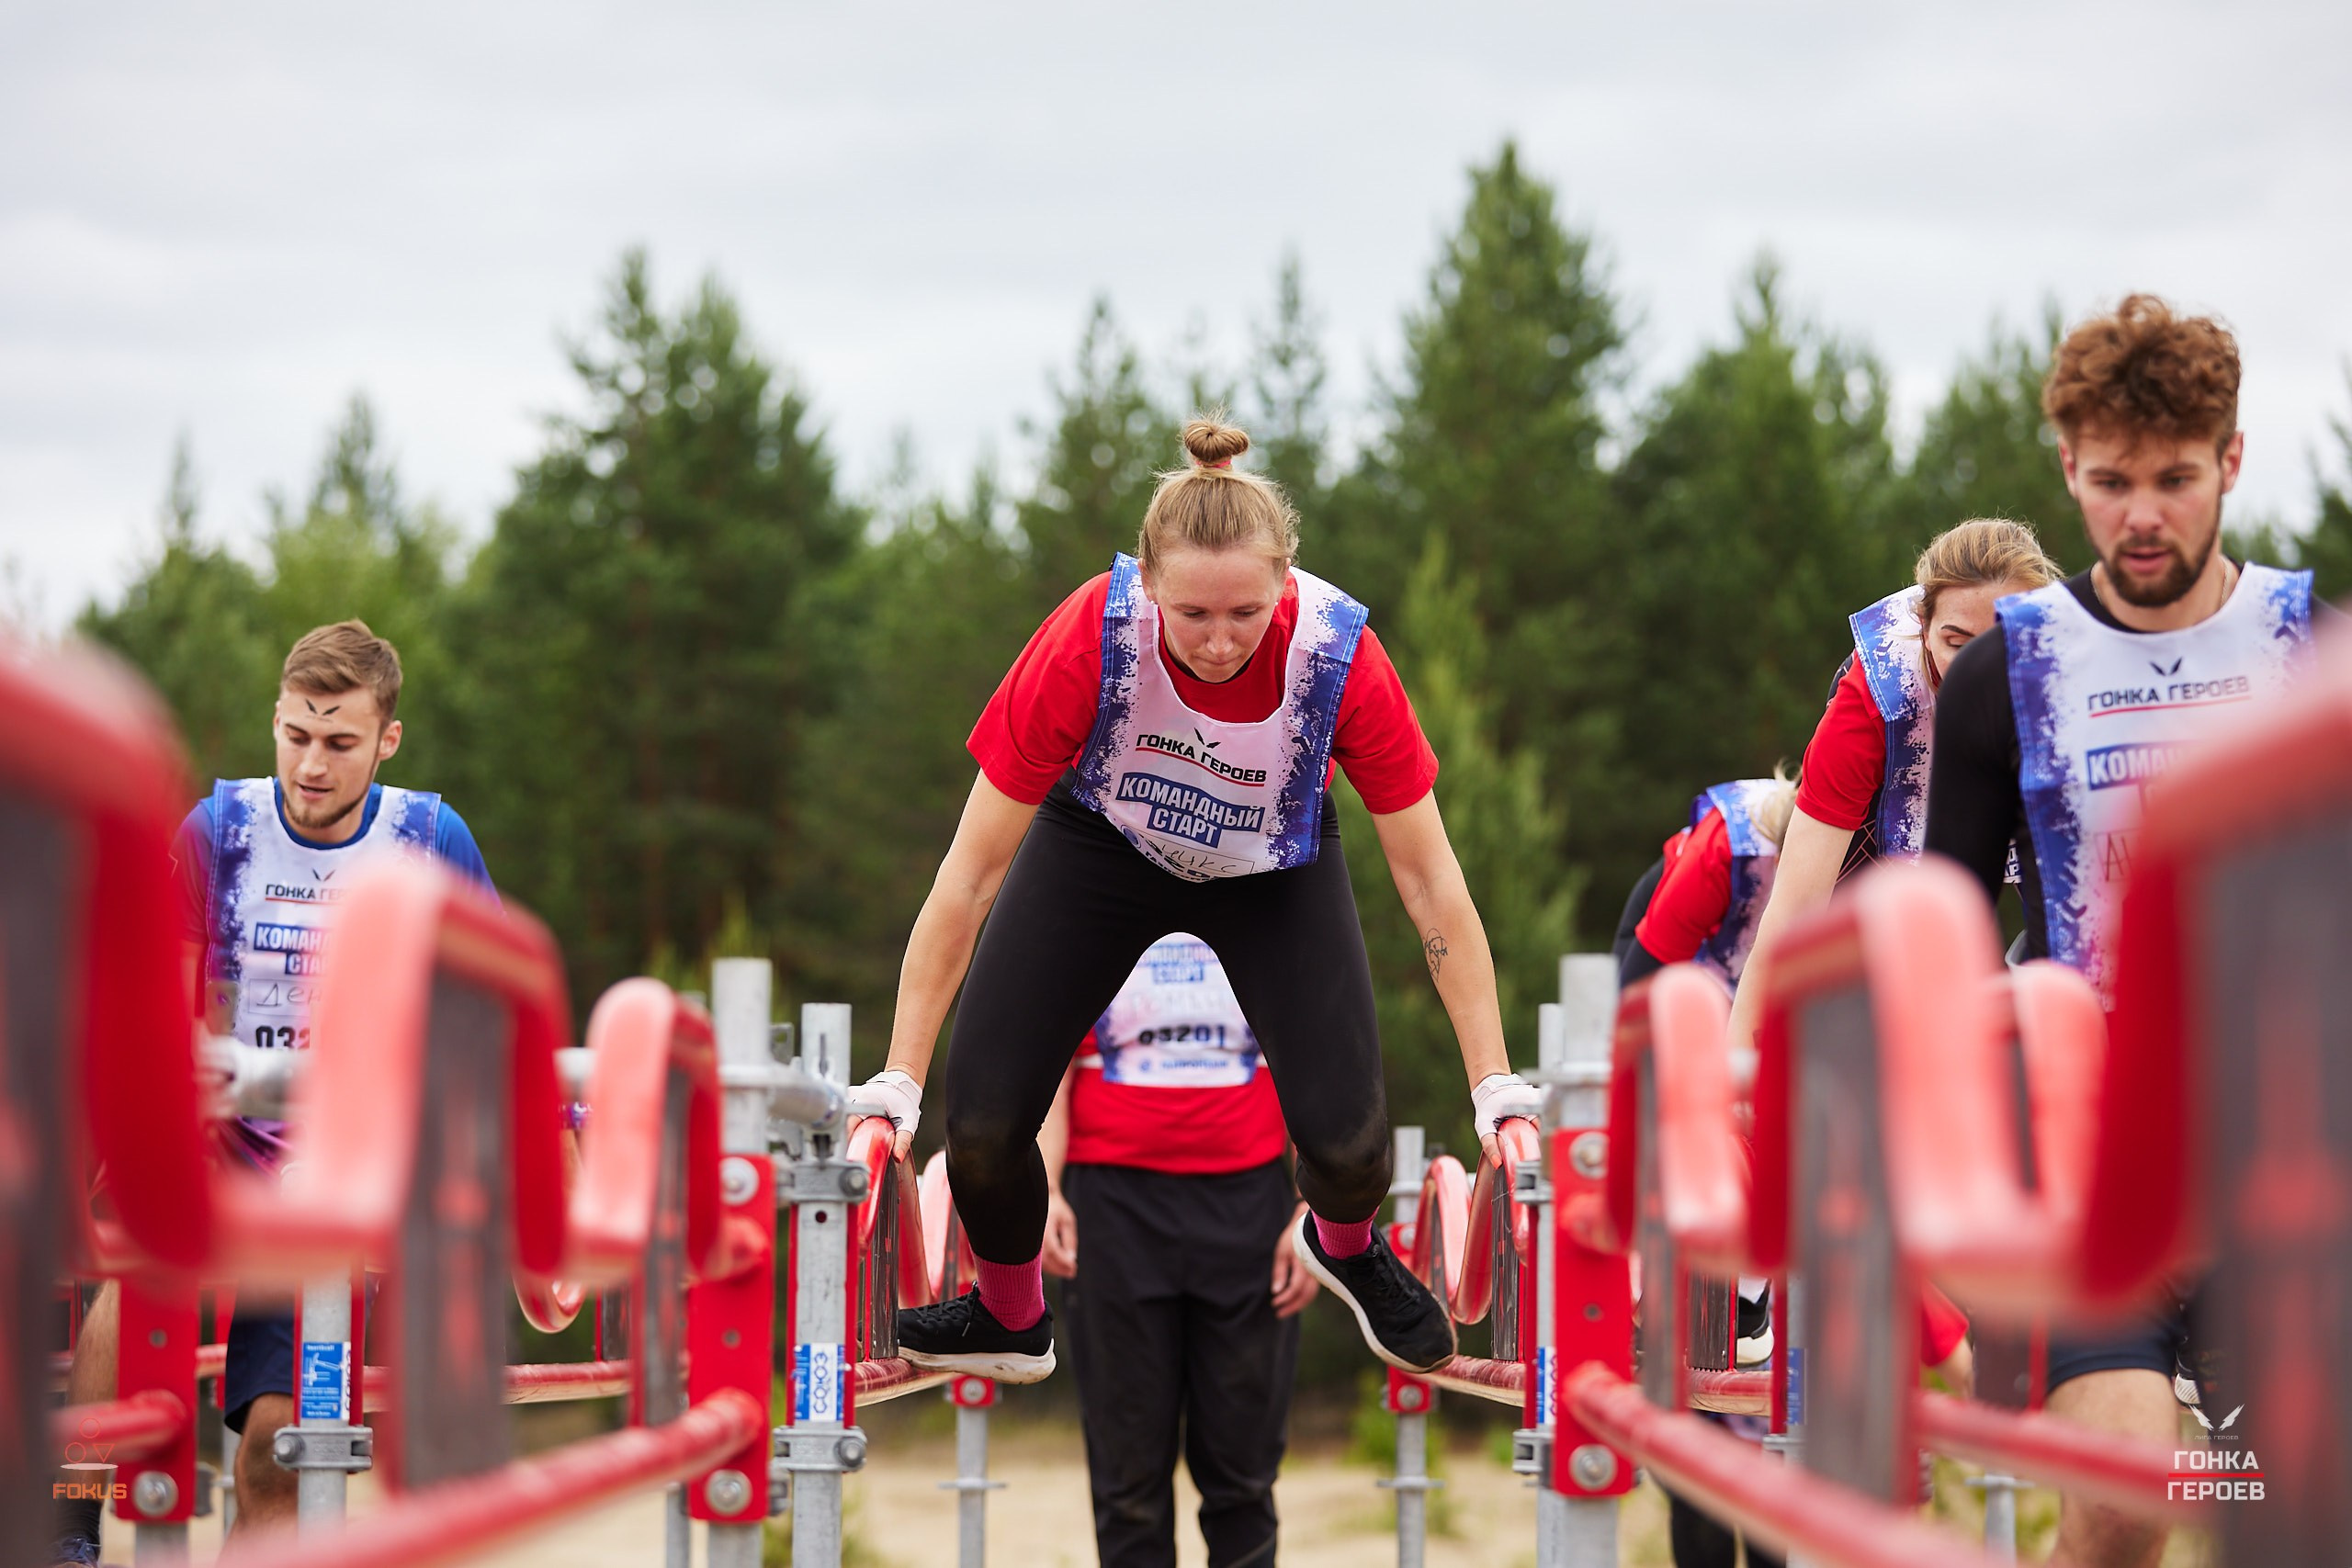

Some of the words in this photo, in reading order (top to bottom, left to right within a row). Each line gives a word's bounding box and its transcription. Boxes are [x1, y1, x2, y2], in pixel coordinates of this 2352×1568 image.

[2088, 688, 2160, 711] ГОНКА
[2167, 675, 2250, 701] ГЕРОЕВ
[1136, 734, 1195, 760] ГОНКА
[1200, 751, 1267, 783] ГЕРОЕВ
[1120, 777, 1261, 829] КОМАНДНЫЙ
[1152, 807, 1218, 843] СТАРТ
[266, 884, 316, 900] ГОНКА
